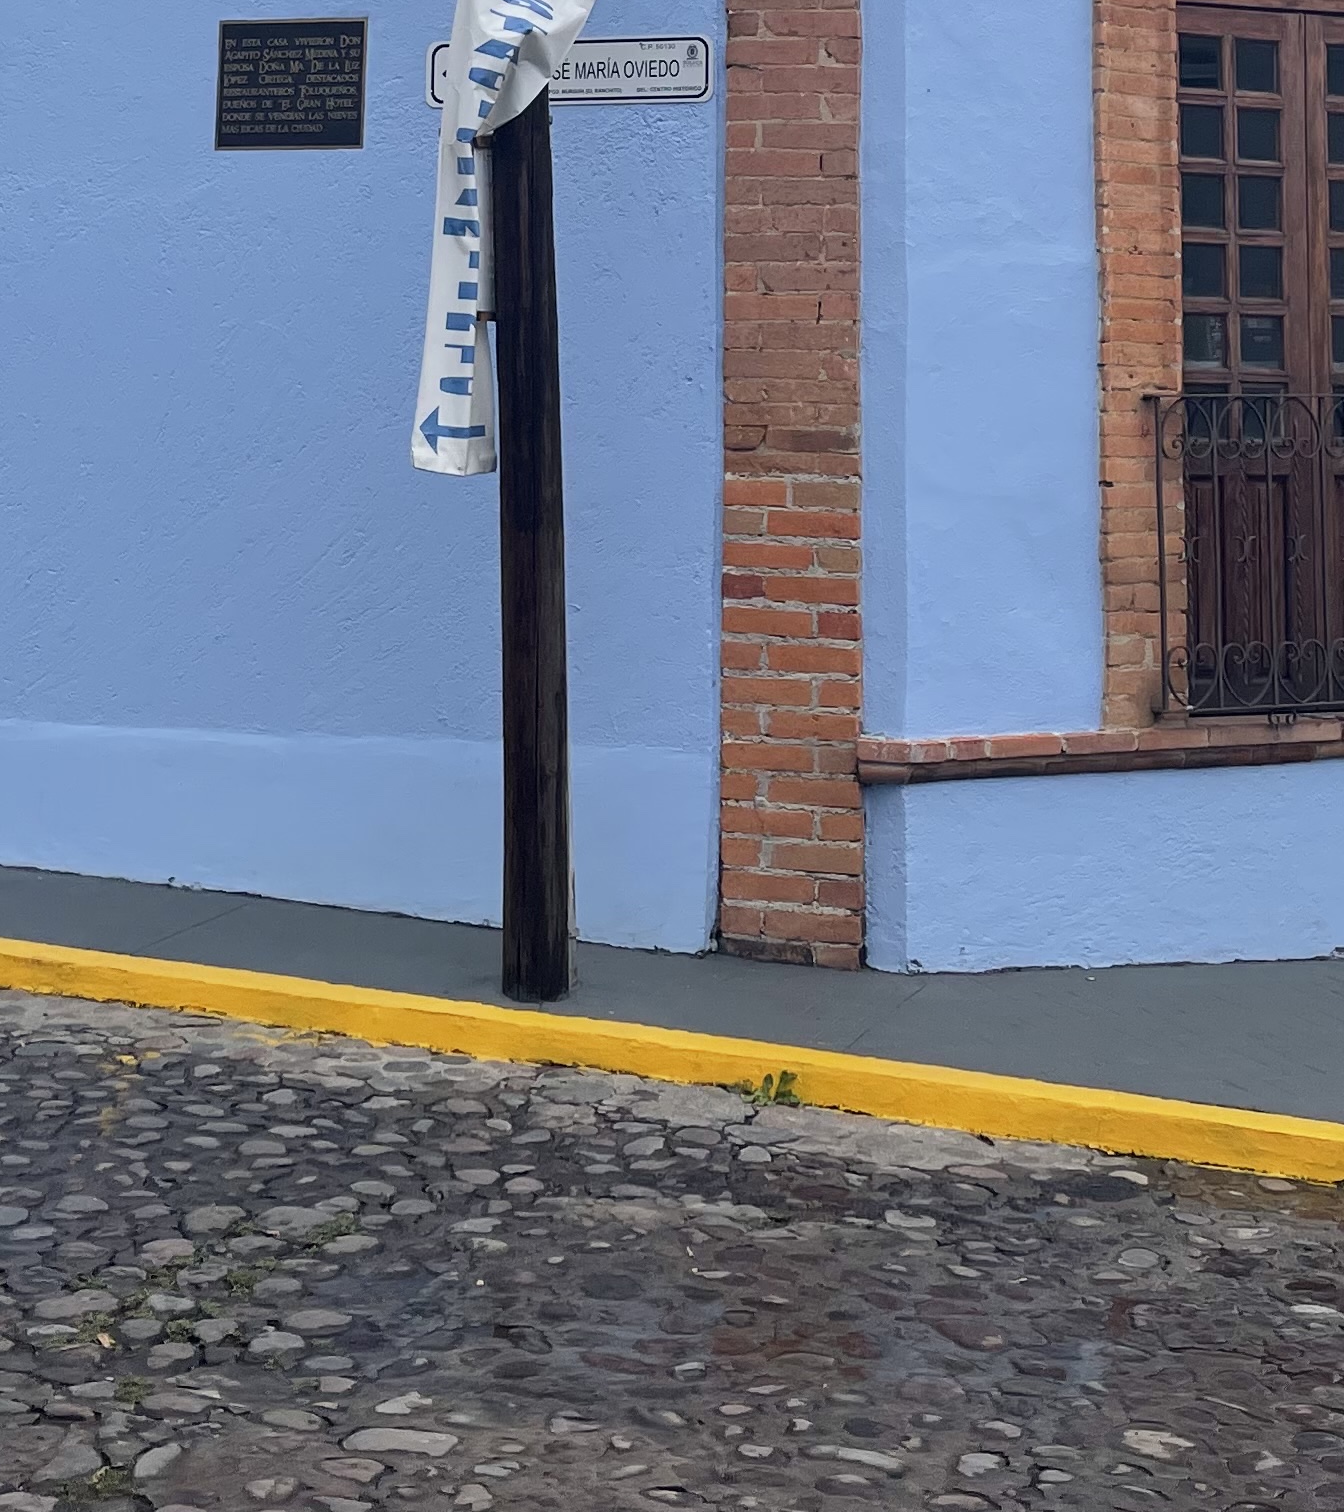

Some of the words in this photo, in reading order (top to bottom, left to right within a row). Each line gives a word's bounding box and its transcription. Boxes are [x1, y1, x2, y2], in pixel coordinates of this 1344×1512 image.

[267, 38, 288, 46] CASA
[574, 56, 621, 80] MARÍA
[623, 59, 680, 79] OVIEDO
